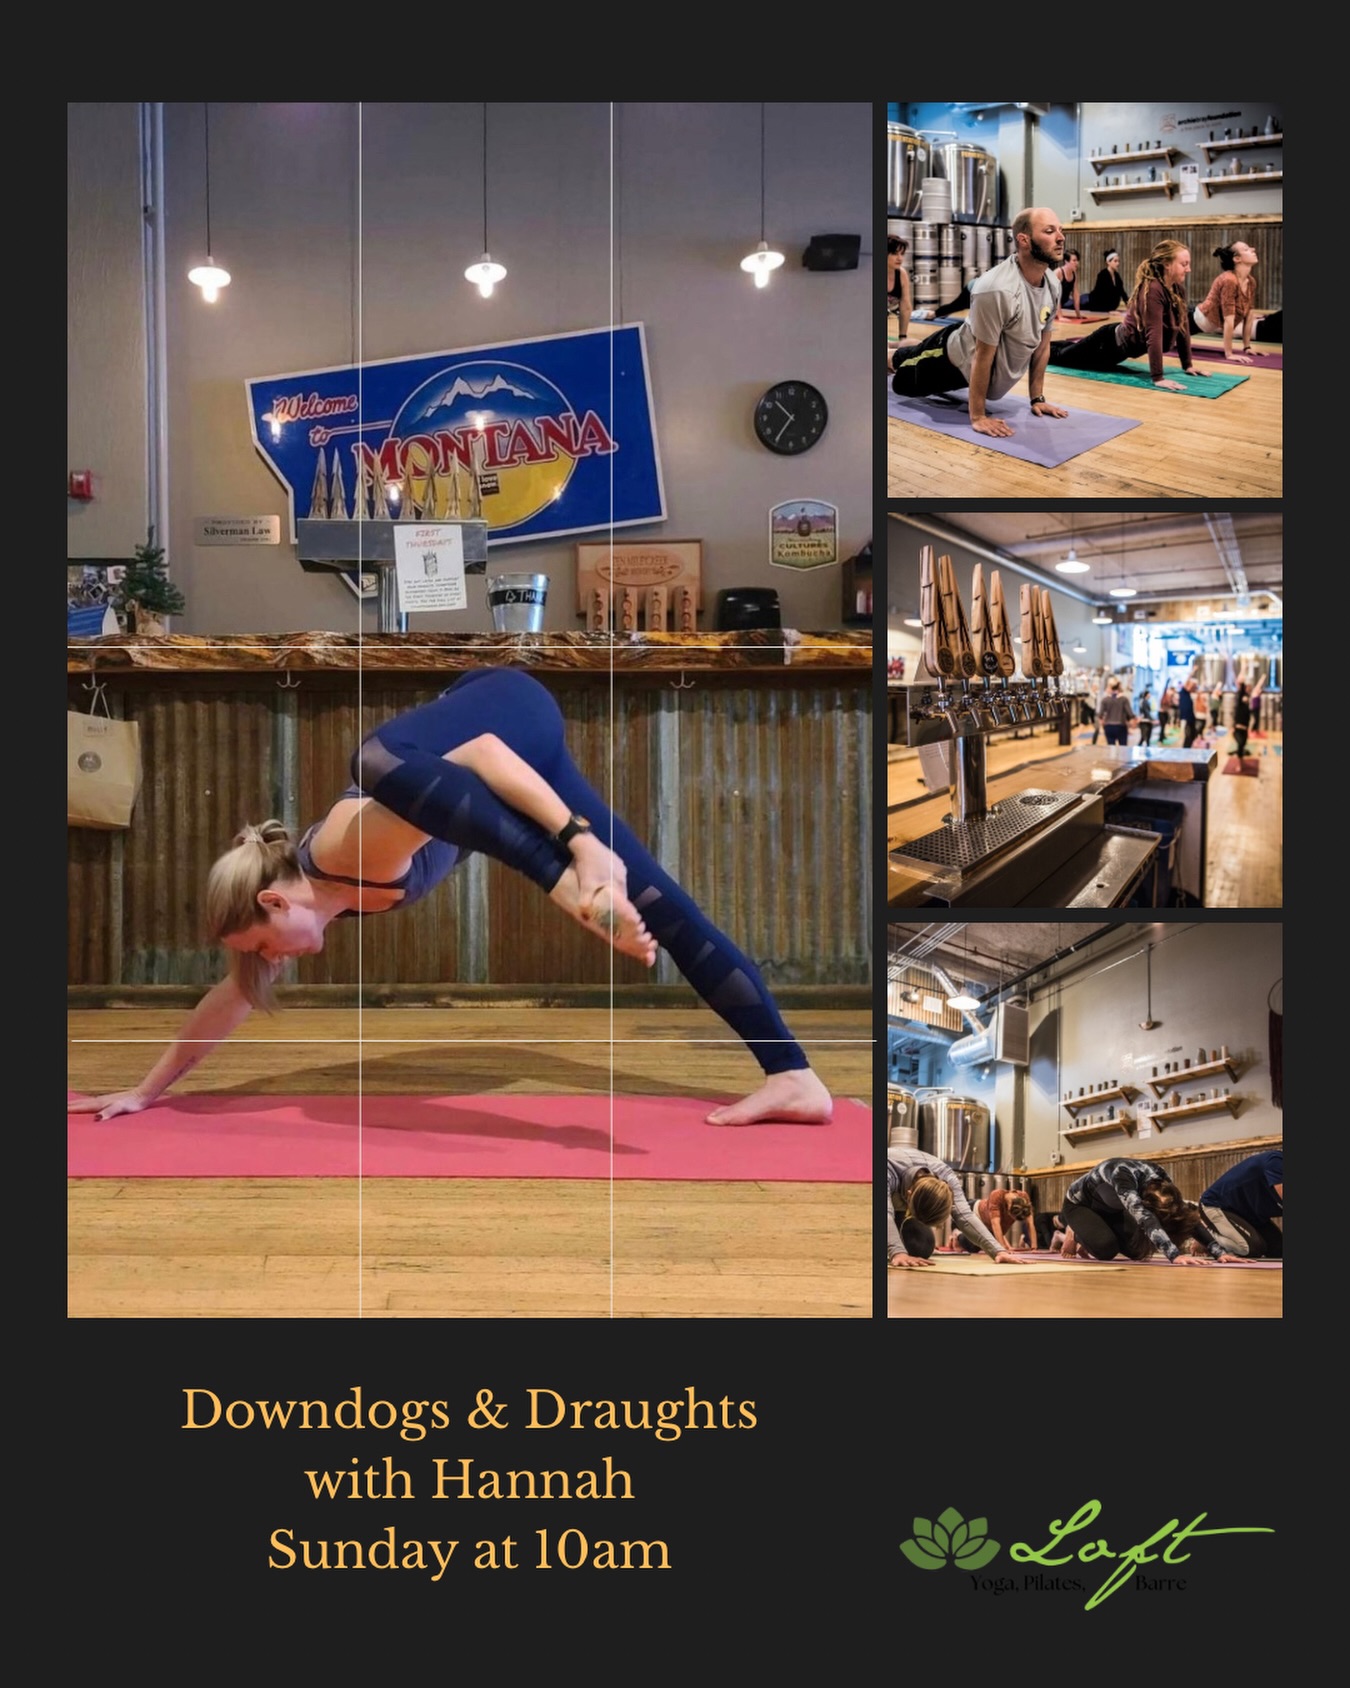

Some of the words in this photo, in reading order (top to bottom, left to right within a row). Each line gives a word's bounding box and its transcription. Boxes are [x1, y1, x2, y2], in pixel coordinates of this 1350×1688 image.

[274, 392, 358, 421] Welcome
[309, 425, 332, 447] to
[353, 409, 619, 486] MONTANA
[203, 527, 250, 536] Silverman
[252, 527, 271, 535] Law
[777, 549, 831, 558] Kombucha
